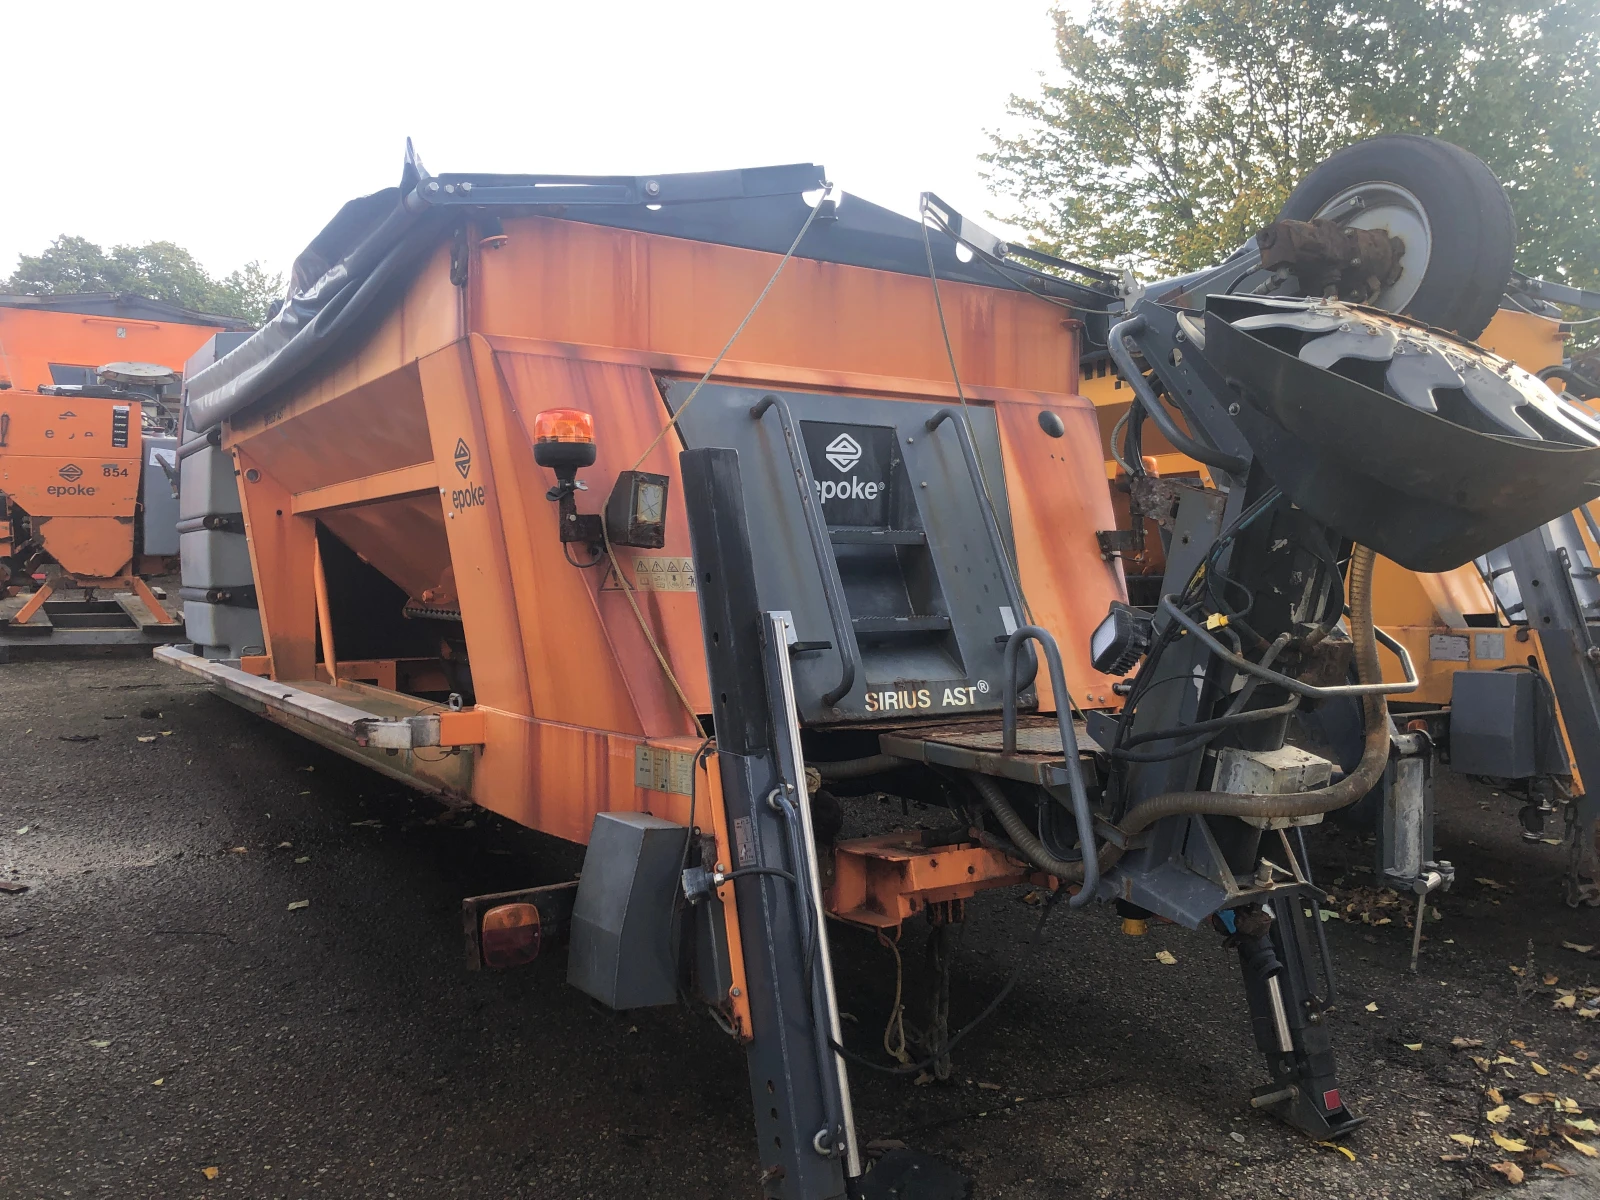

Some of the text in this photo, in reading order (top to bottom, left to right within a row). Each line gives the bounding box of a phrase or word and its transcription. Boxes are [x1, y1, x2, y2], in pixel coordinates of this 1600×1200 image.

[103, 467, 129, 478] 854
[46, 483, 96, 498] epoke
[452, 481, 485, 514] epoke
[864, 689, 931, 712] SIRIUS
